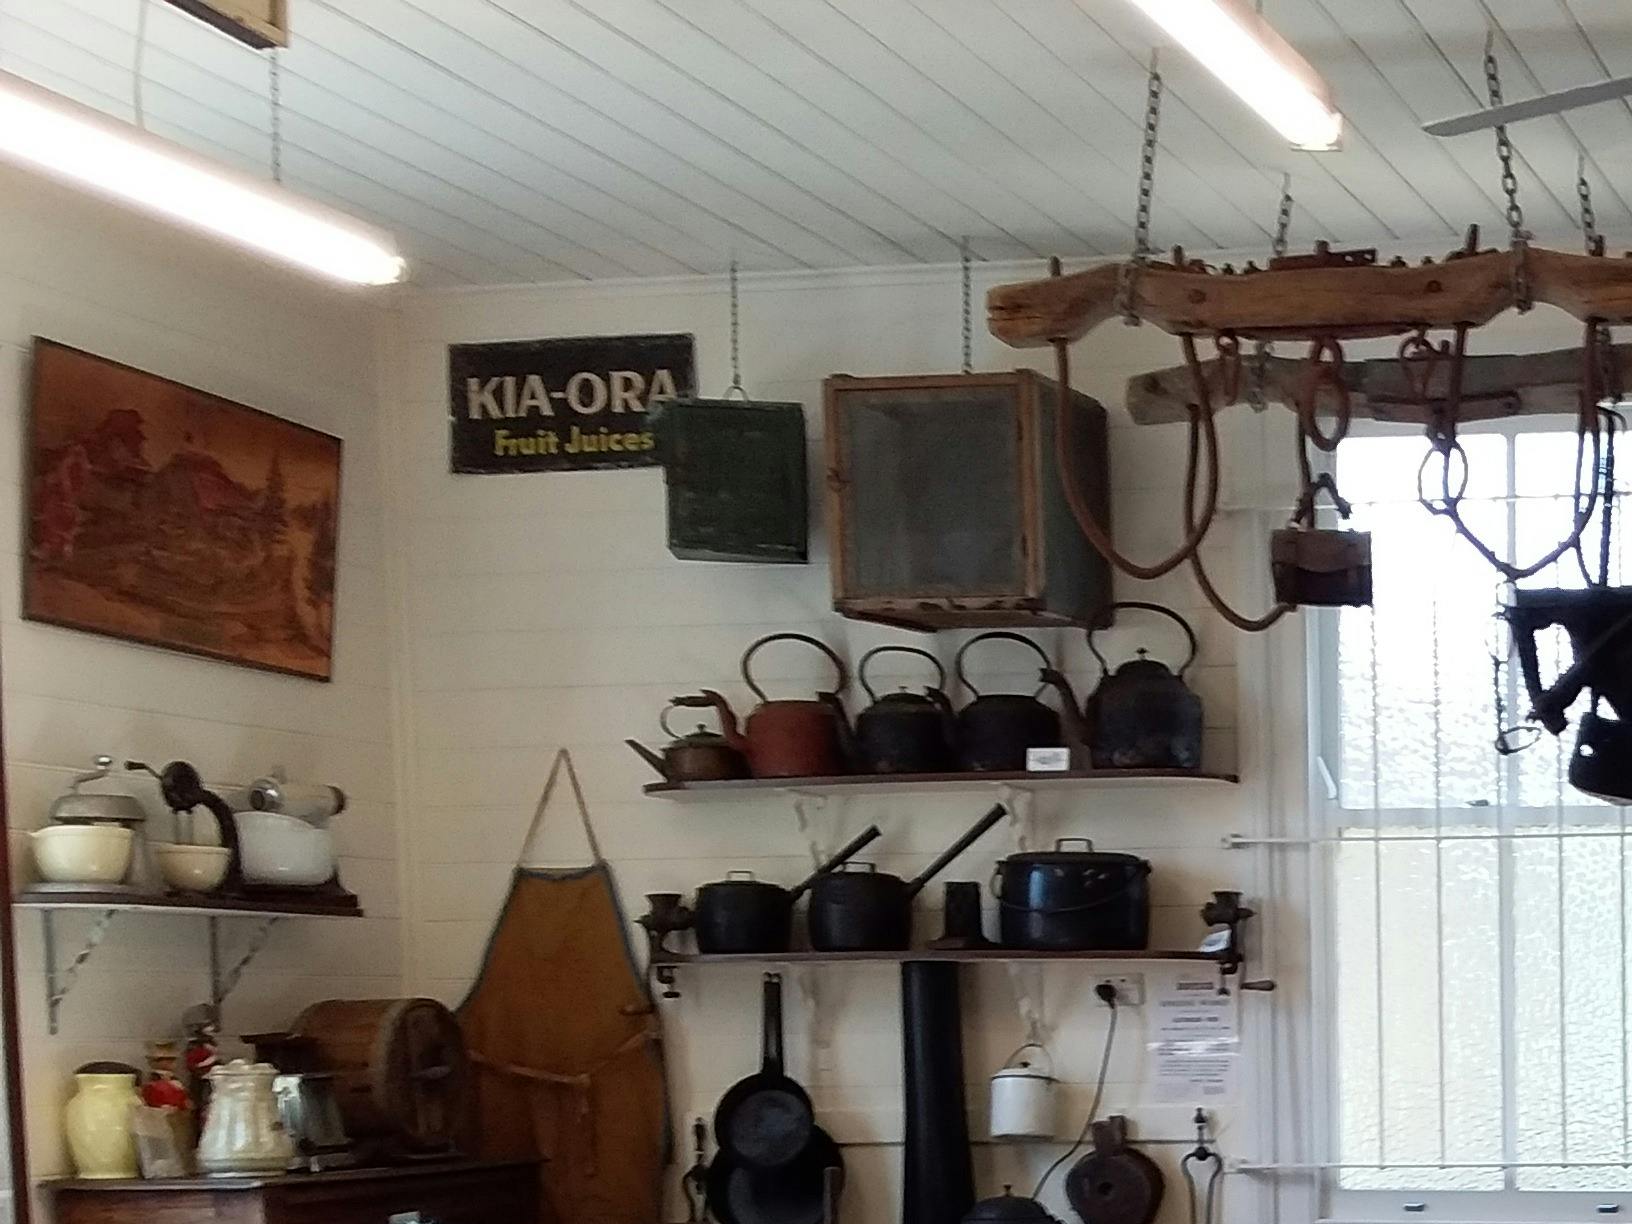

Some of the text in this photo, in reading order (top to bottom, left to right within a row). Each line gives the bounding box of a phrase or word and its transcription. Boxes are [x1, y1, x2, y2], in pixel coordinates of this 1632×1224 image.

[466, 369, 678, 419] KIA-ORA
[494, 426, 655, 457] Fruit Juices
